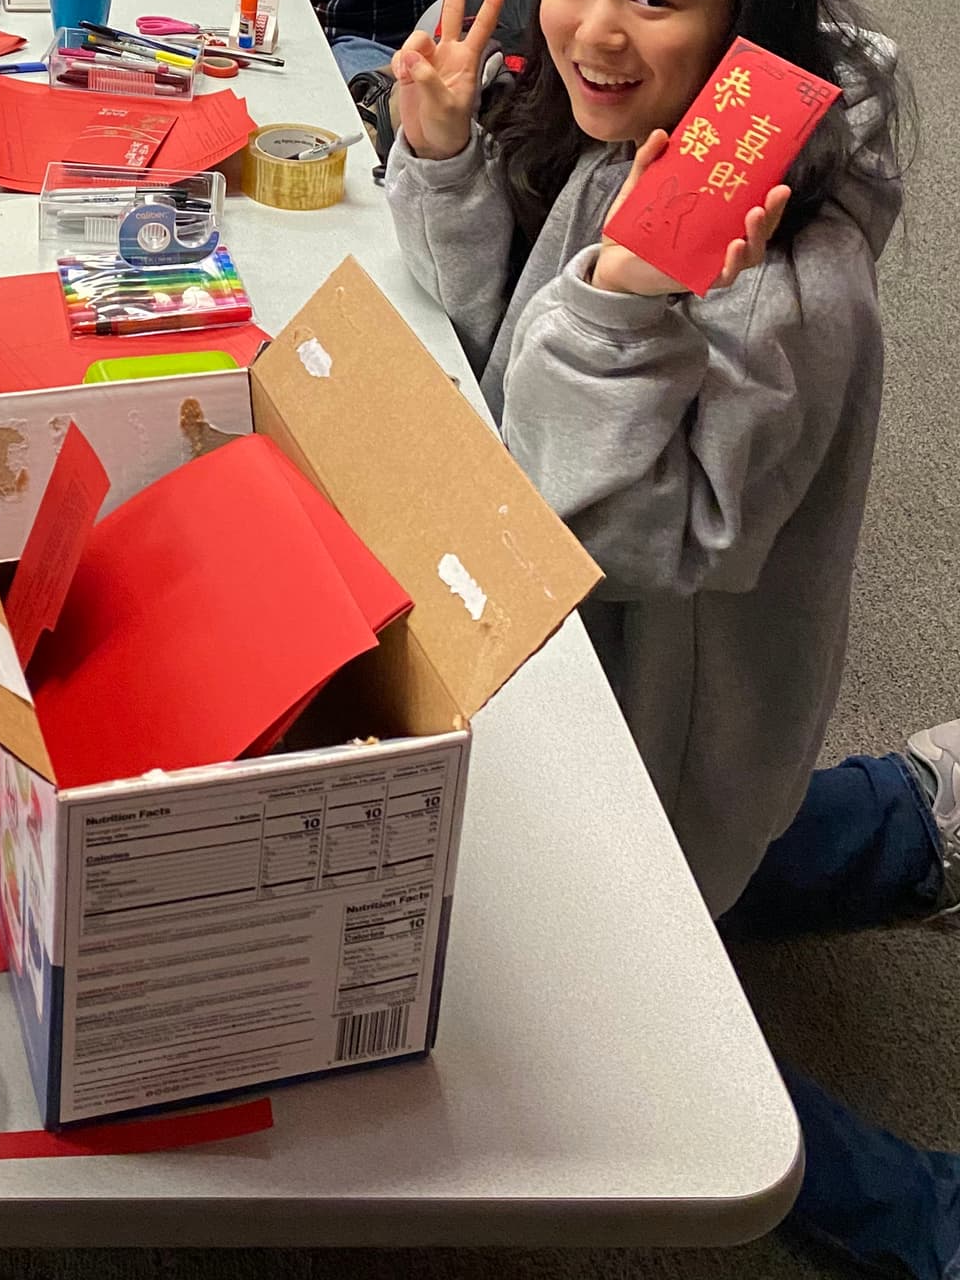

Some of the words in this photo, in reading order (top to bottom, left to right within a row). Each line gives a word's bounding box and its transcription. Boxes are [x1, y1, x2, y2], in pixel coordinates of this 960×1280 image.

[424, 796, 440, 808] 10
[85, 812, 137, 826] Nutrition
[139, 807, 171, 819] Facts
[364, 807, 382, 819] 10
[302, 818, 320, 829] 10
[346, 899, 397, 914] Nutrition
[399, 891, 430, 905] Facts
[409, 918, 425, 930] 10
